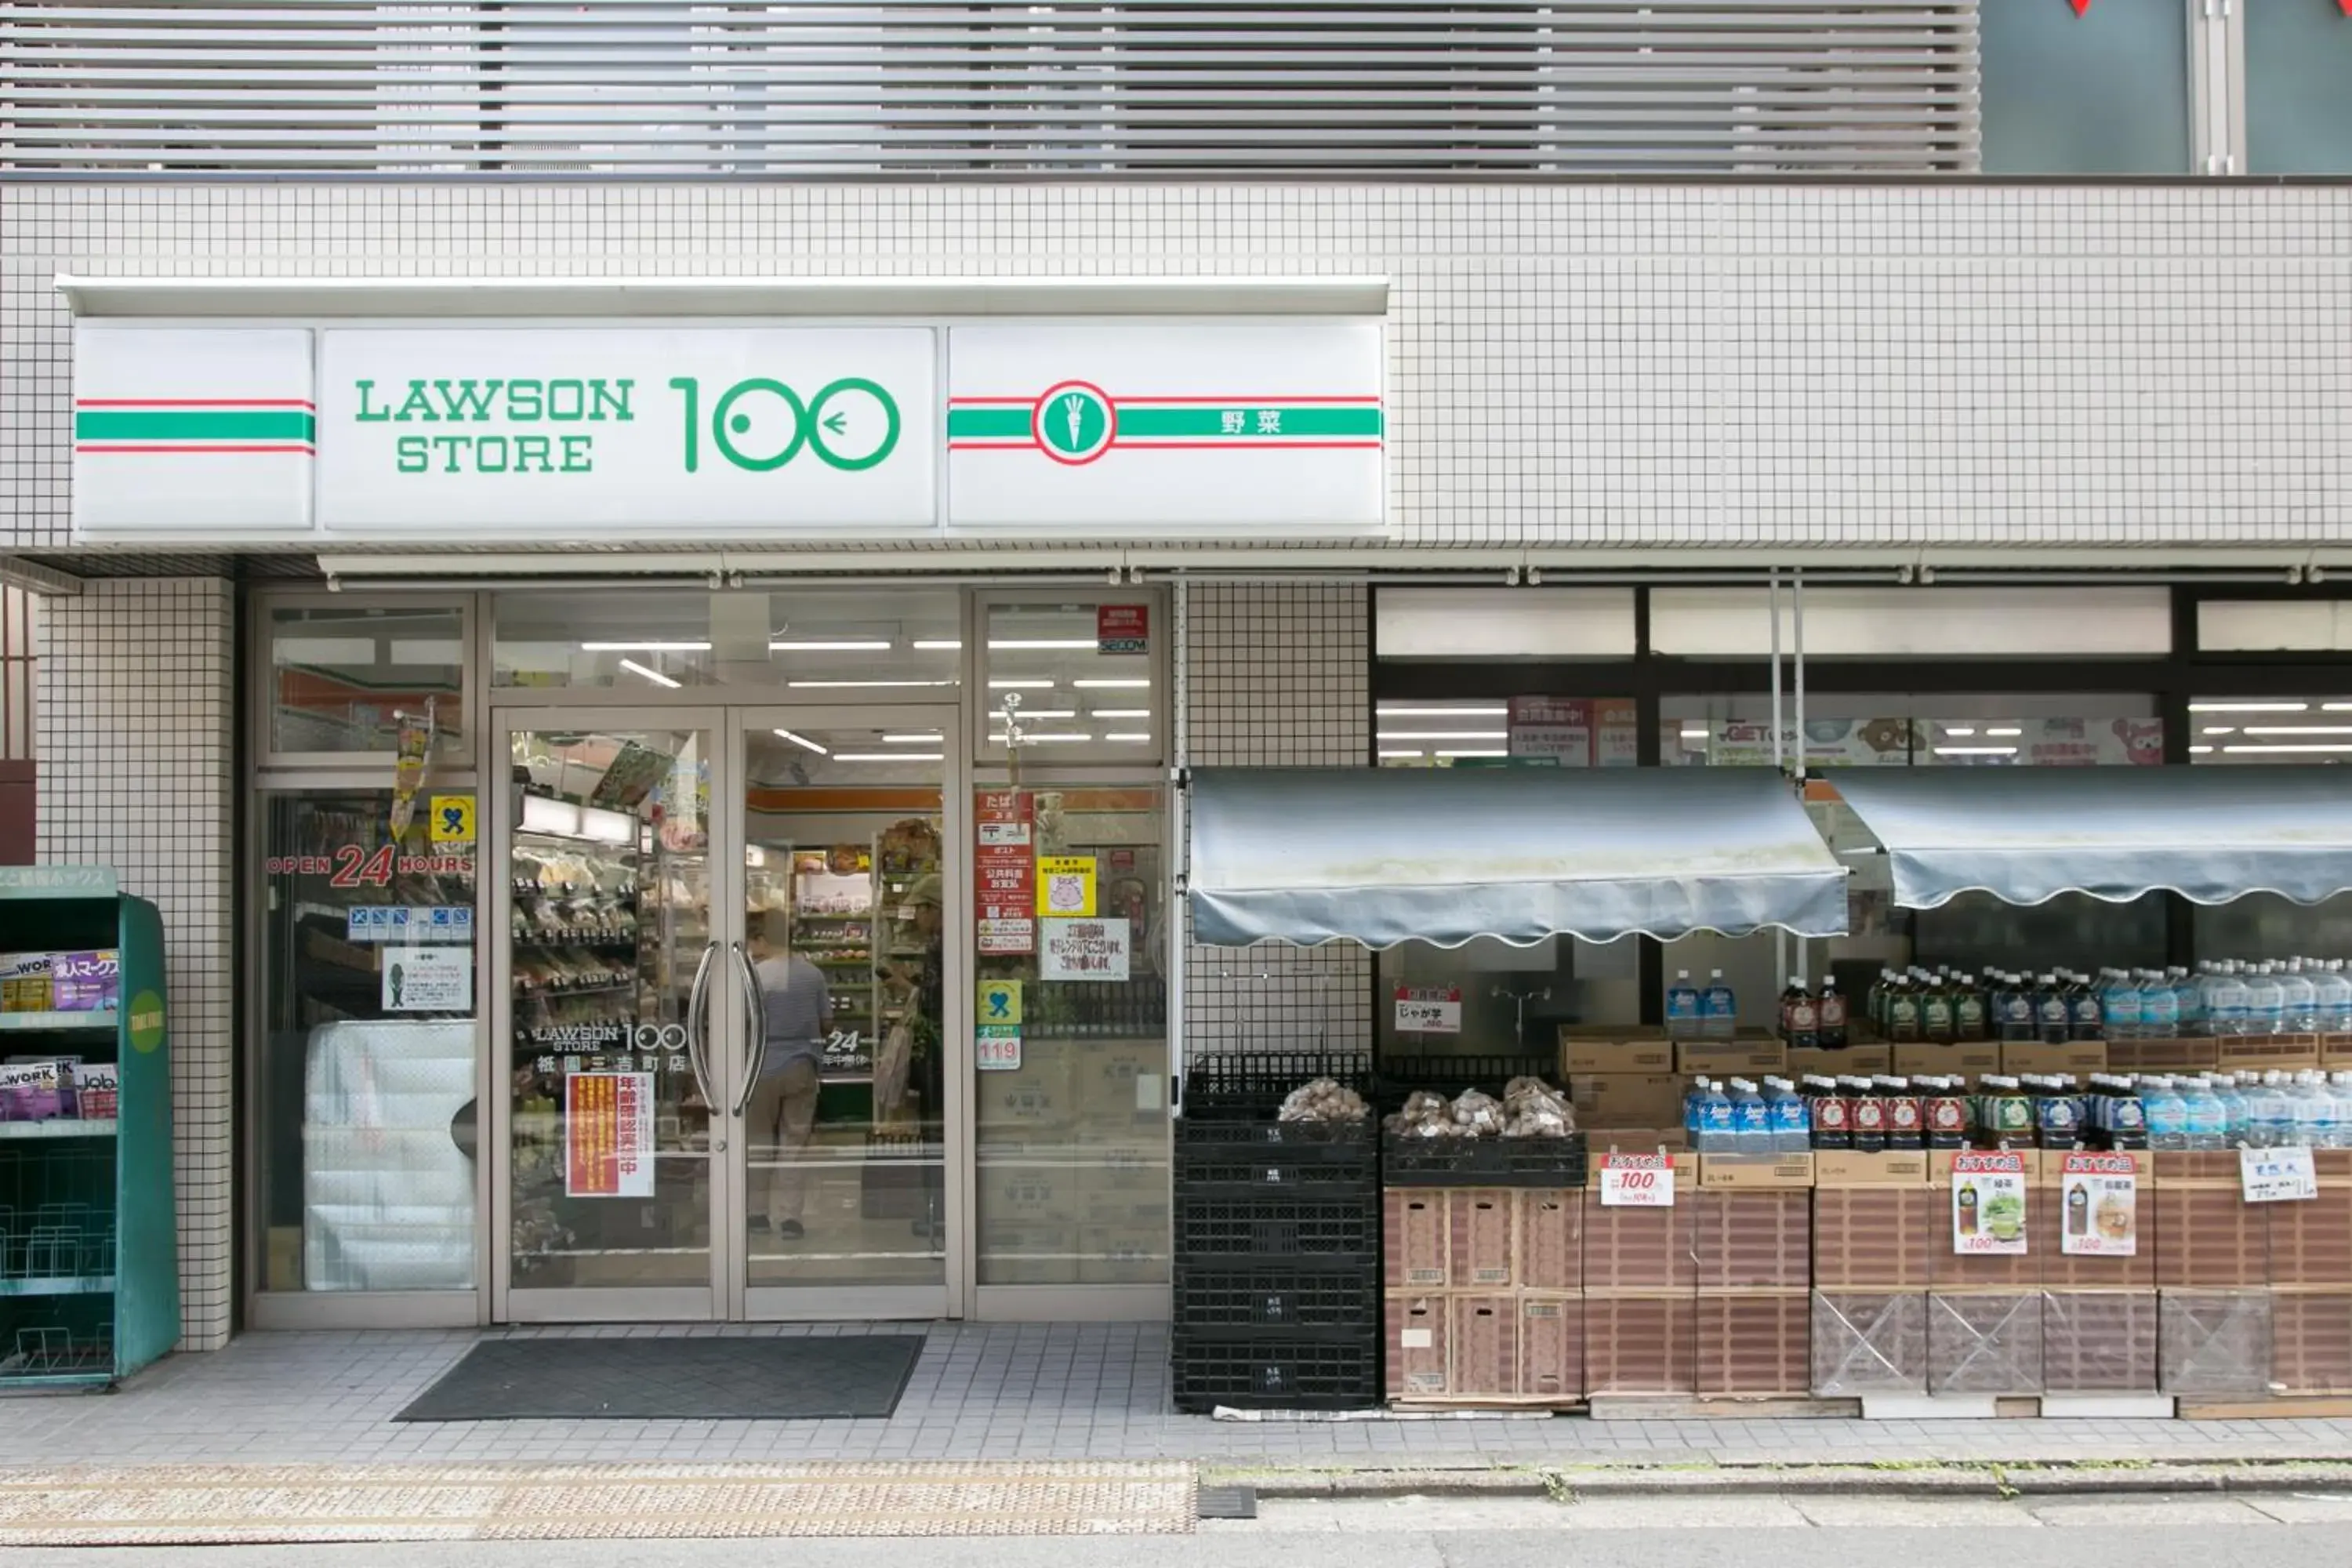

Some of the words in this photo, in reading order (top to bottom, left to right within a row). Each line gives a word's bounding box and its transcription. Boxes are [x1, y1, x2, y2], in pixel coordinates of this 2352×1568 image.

[355, 379, 634, 421] LAWSON
[669, 377, 901, 473] 100
[1221, 410, 1281, 434] 野菜
[397, 435, 592, 473] STORE
[1101, 639, 1145, 652] SECOM
[987, 795, 1014, 808] たば
[267, 856, 332, 874] OPEN
[330, 844, 396, 887] 24
[397, 855, 473, 874] HOURS
[17, 959, 51, 974] WOR
[536, 1025, 619, 1041] LAWSON
[826, 1029, 858, 1052] 24
[1621, 1172, 1654, 1189] 100
